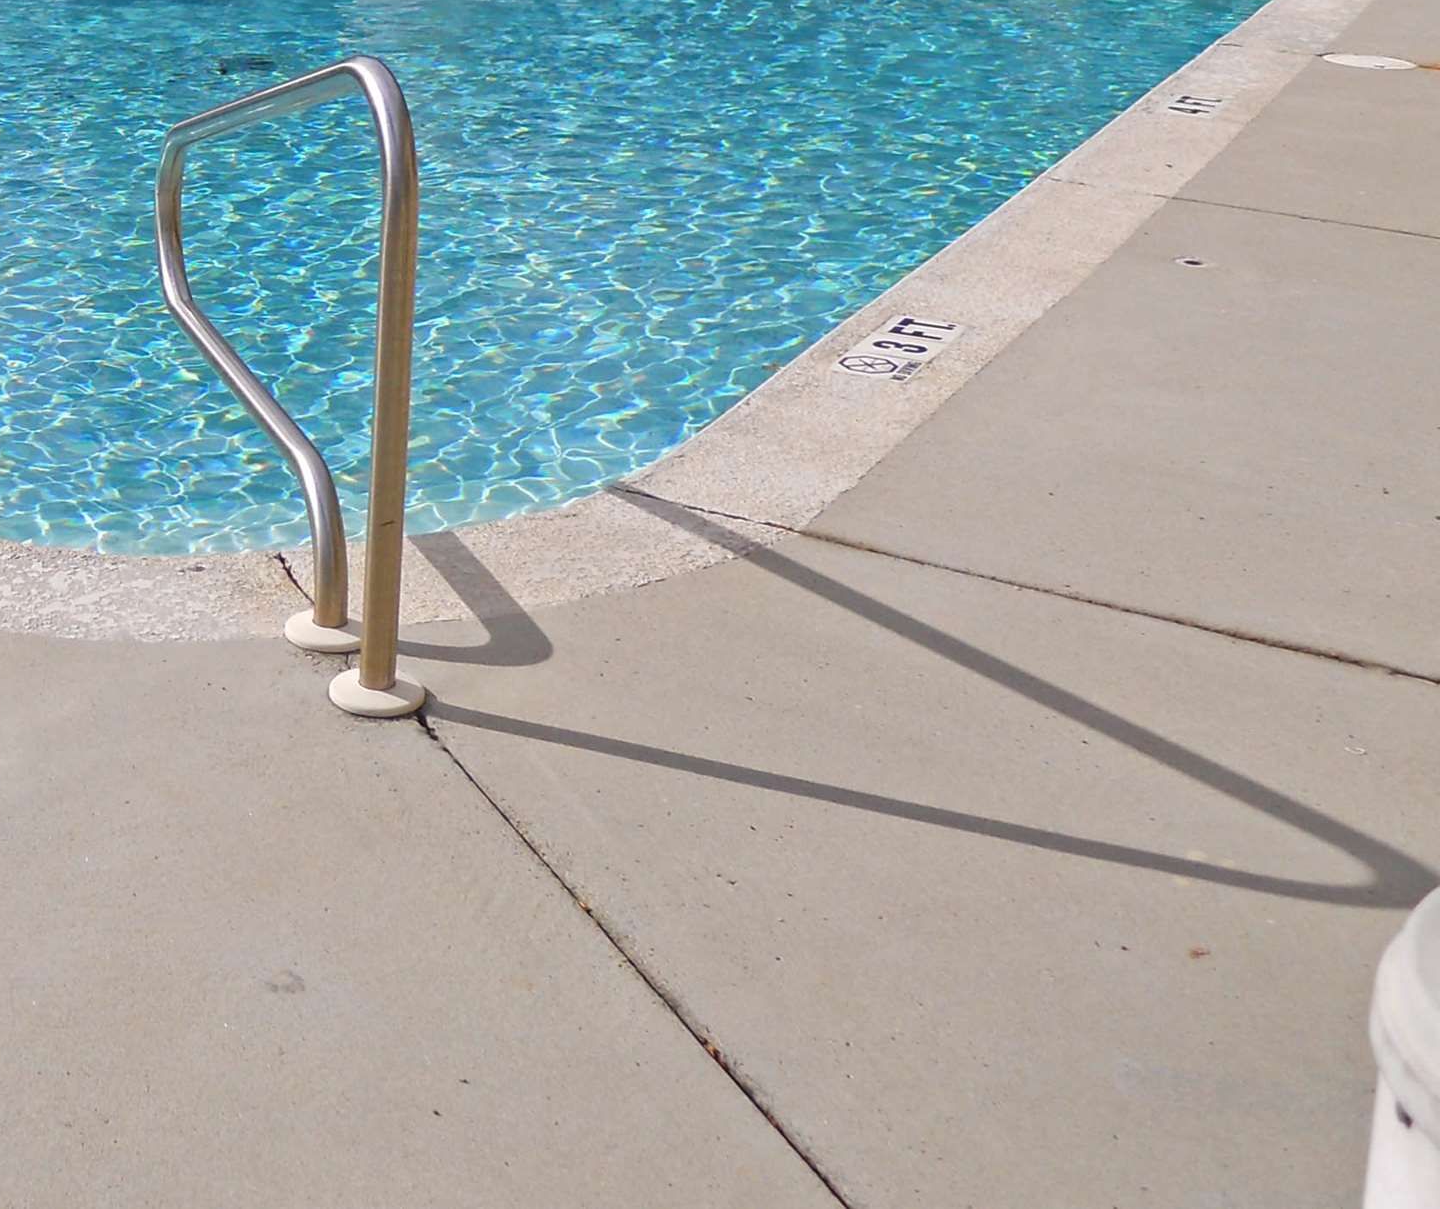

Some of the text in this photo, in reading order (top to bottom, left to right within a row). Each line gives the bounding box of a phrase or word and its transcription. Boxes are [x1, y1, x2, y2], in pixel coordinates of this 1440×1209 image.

[1167, 95, 1222, 114] 4 FT
[872, 339, 928, 354] 3
